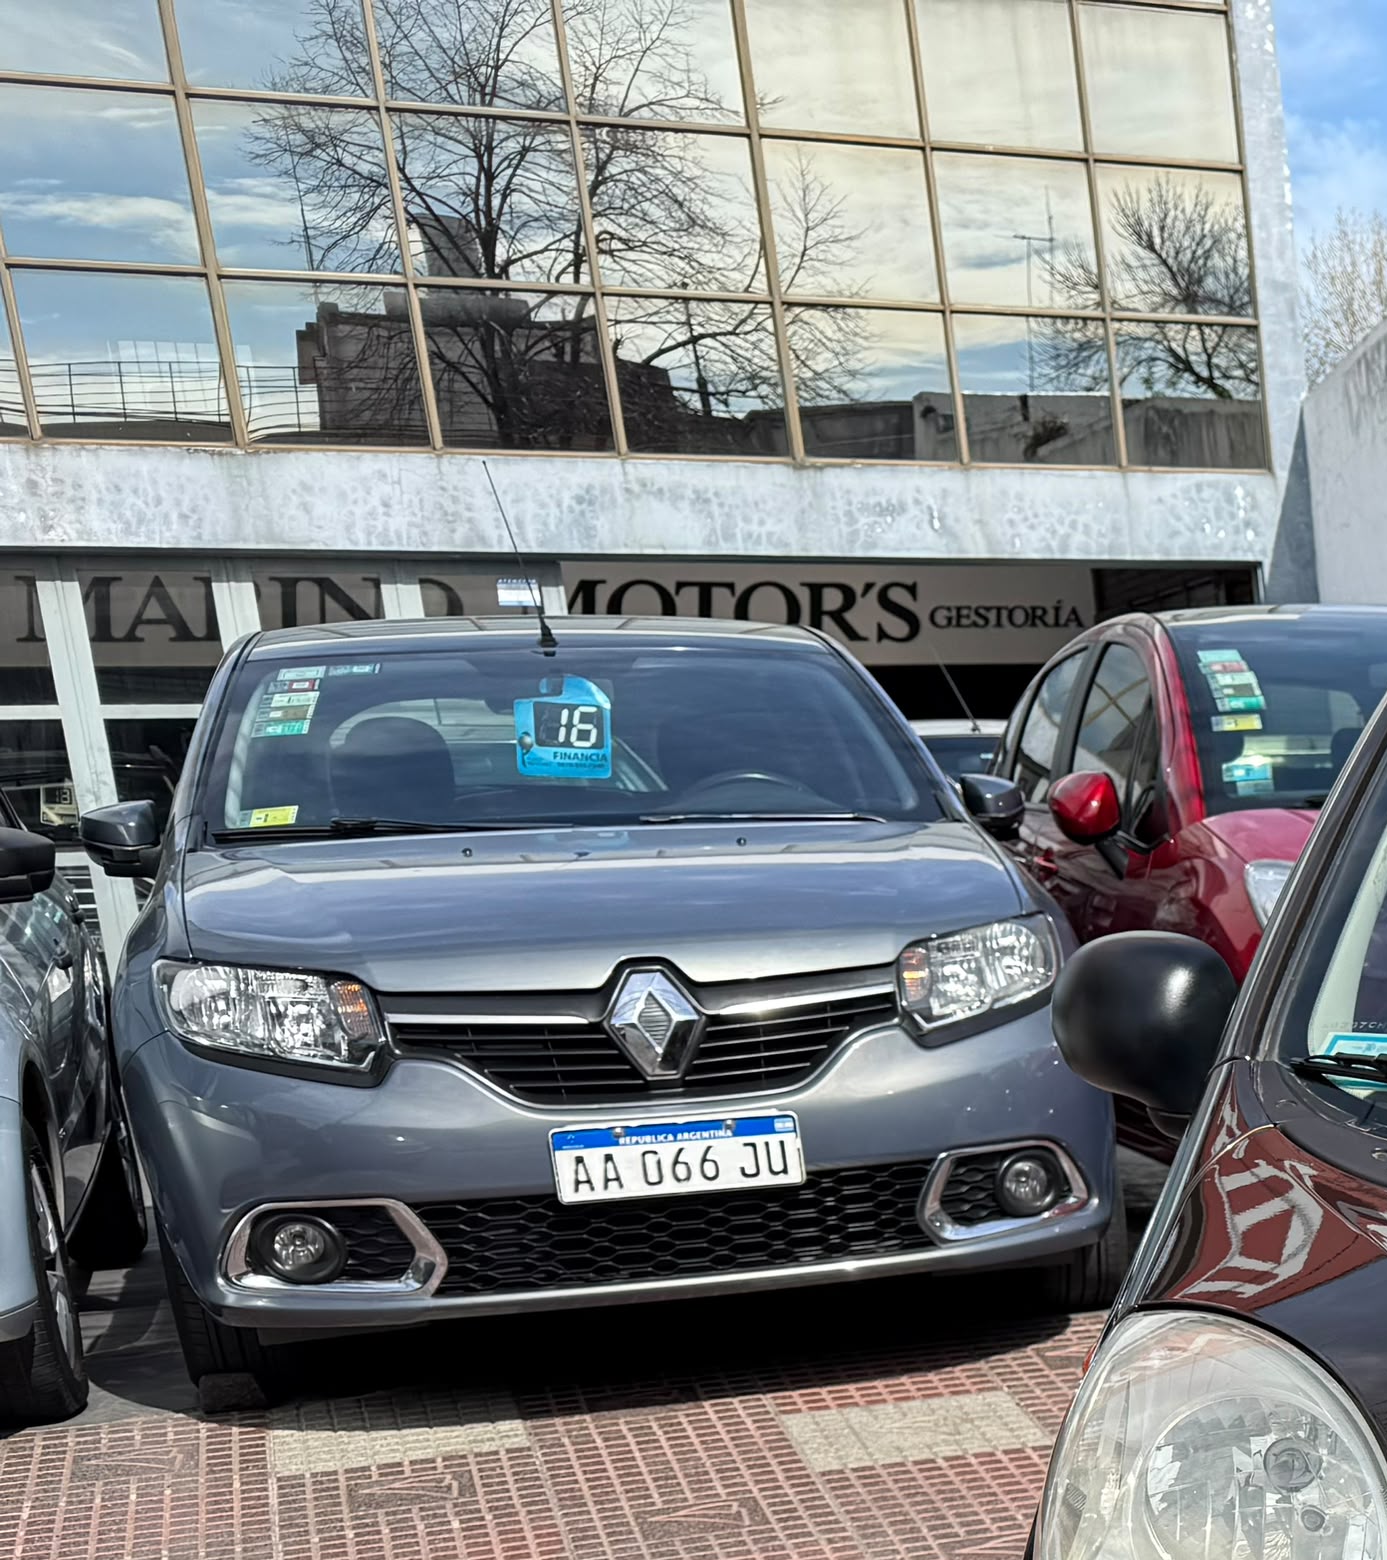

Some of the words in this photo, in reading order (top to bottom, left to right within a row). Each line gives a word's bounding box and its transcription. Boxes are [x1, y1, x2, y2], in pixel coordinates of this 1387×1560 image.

[14, 574, 464, 643] MAIN
[929, 600, 1084, 629] GESTORÍA
[558, 705, 598, 748] 16
[619, 1133, 674, 1145] REPUBLICA
[676, 1129, 733, 1141] ARGENTINA
[573, 1153, 624, 1193] AA
[641, 1146, 720, 1186] 066
